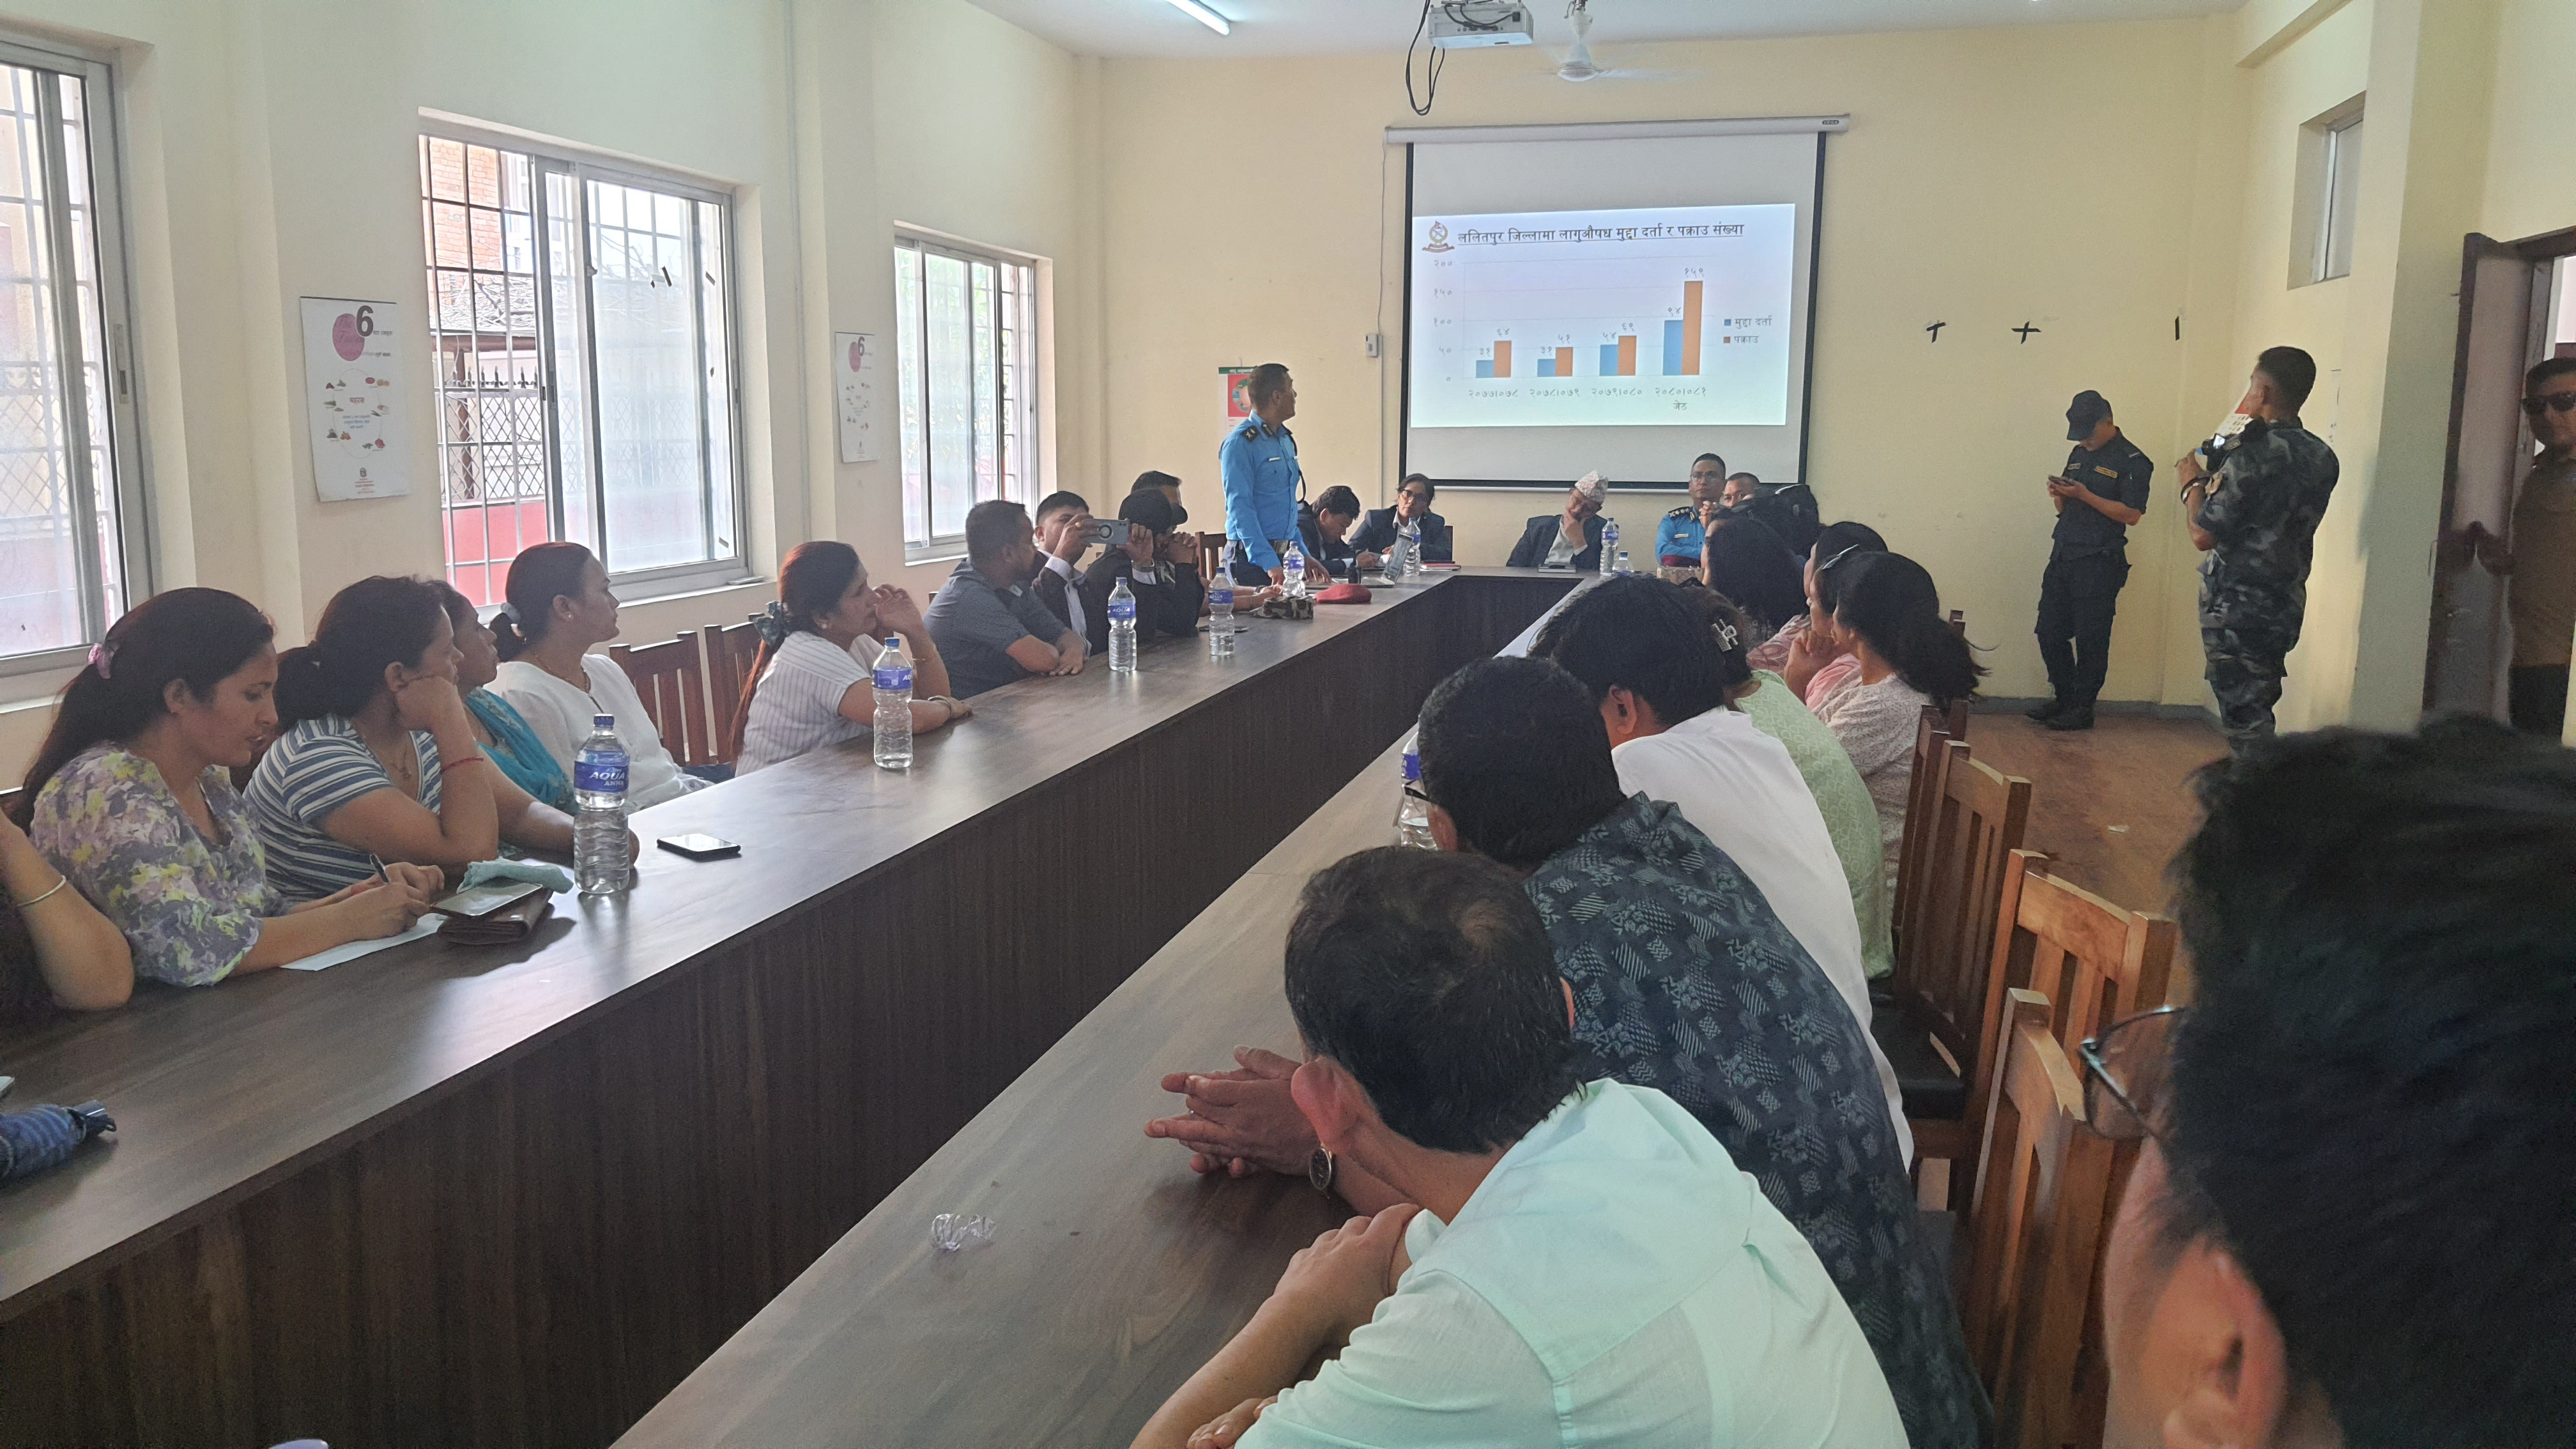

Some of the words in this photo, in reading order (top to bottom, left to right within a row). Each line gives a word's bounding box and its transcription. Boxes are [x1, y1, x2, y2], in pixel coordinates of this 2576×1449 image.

[1458, 229, 1505, 245] ललितपुर
[1508, 227, 1556, 241] जिल्लामा
[1616, 227, 1638, 241] मुद्दा
[1641, 223, 1662, 237] दर्ता
[1666, 226, 1675, 236] र
[1677, 226, 1710, 237] पक्राउ
[1713, 222, 1745, 235] संख्या
[1434, 259, 1452, 269] २००
[356, 305, 374, 337] 6
[1755, 315, 1773, 326] दर्ता
[858, 336, 865, 356] 6
[1673, 400, 1687, 410] जेठ
[589, 771, 625, 780] AQUA
